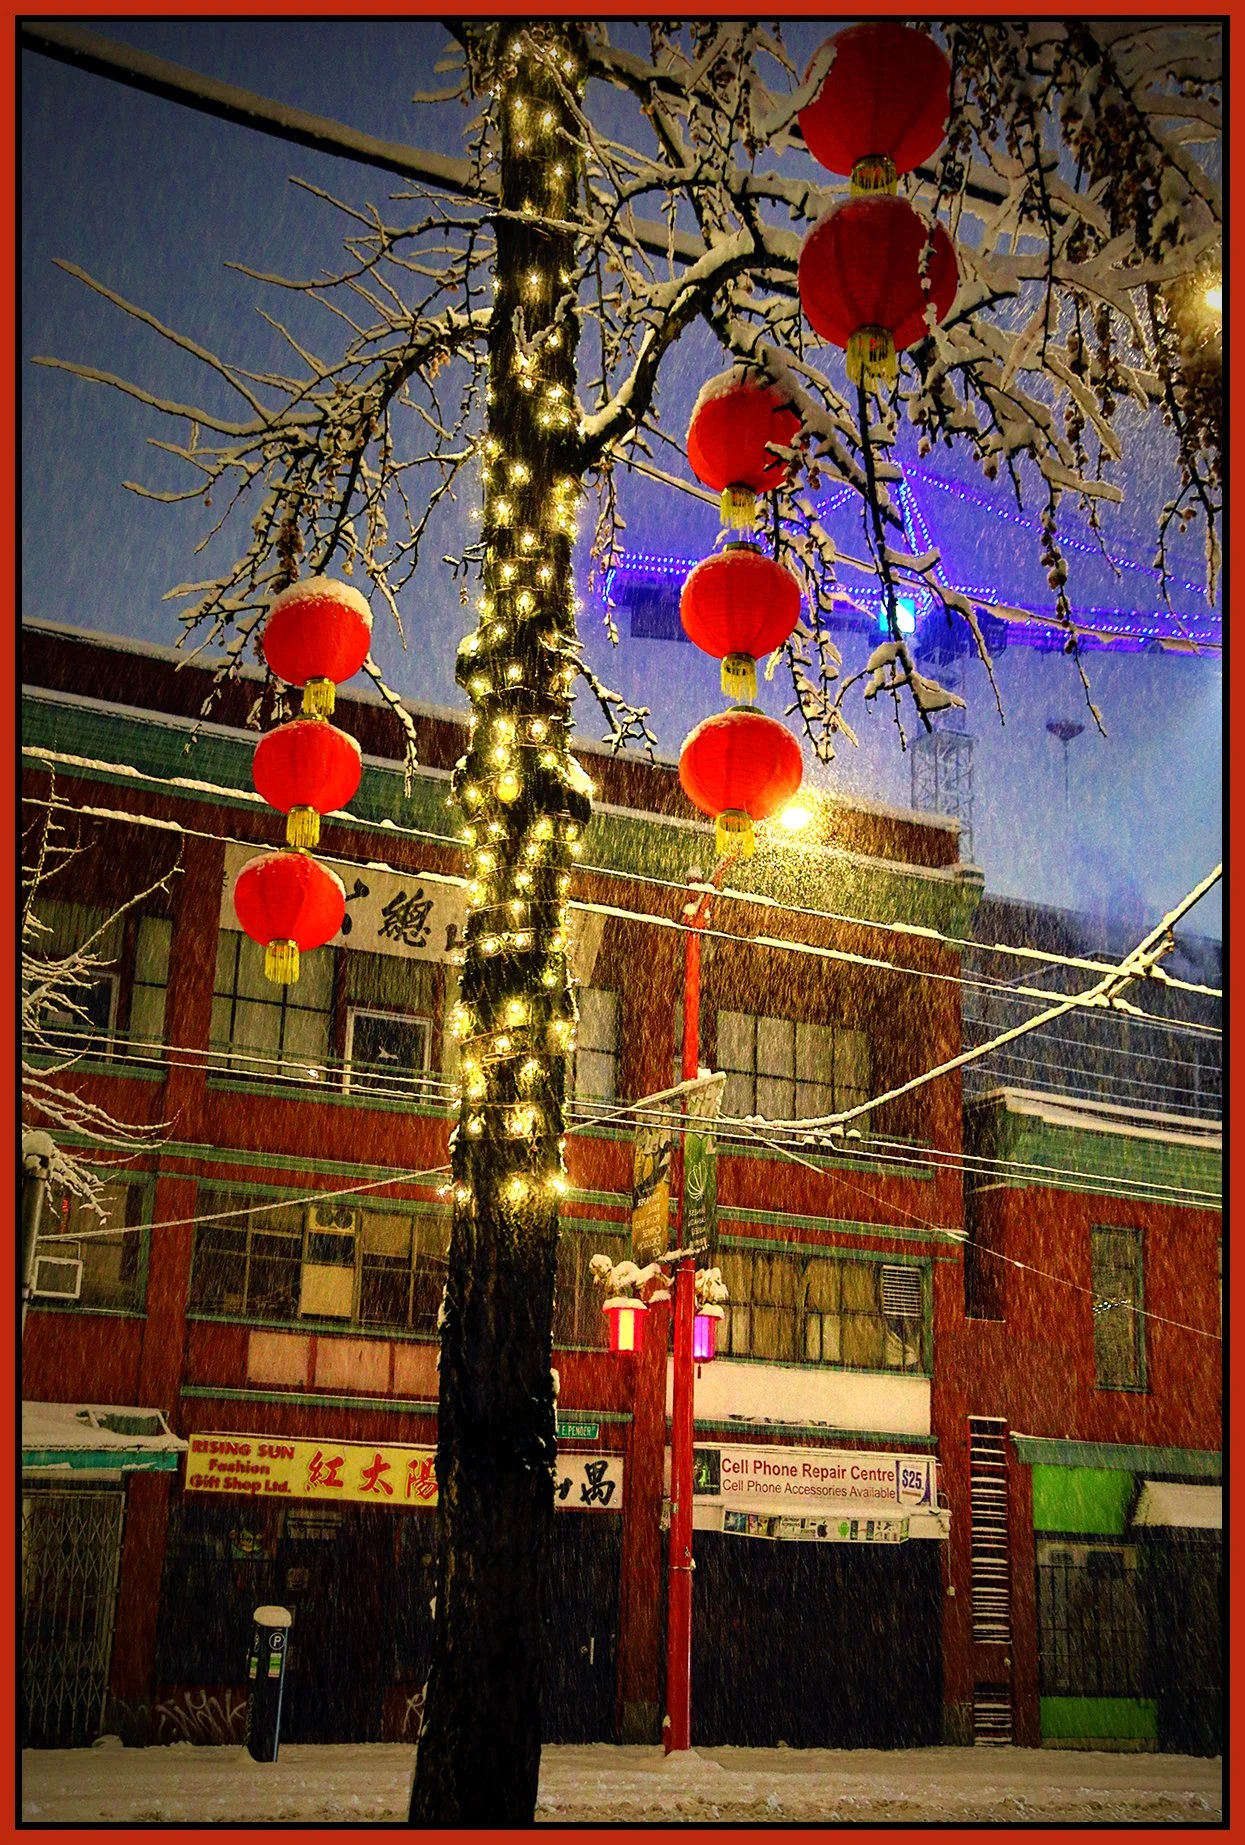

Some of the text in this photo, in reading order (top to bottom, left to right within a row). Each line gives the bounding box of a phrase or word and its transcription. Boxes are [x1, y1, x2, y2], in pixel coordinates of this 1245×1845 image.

[192, 1439, 295, 1459] RISING SUN
[208, 1458, 271, 1475] Fashion
[721, 1458, 895, 1482] Cell Phone Repair Centre
[189, 1474, 292, 1494] Gift Shop Ltd.
[722, 1479, 744, 1492] Cell
[747, 1480, 782, 1494] Phone
[784, 1482, 847, 1497] Accessories
[849, 1485, 896, 1499] Available
[273, 1635, 282, 1647] P
